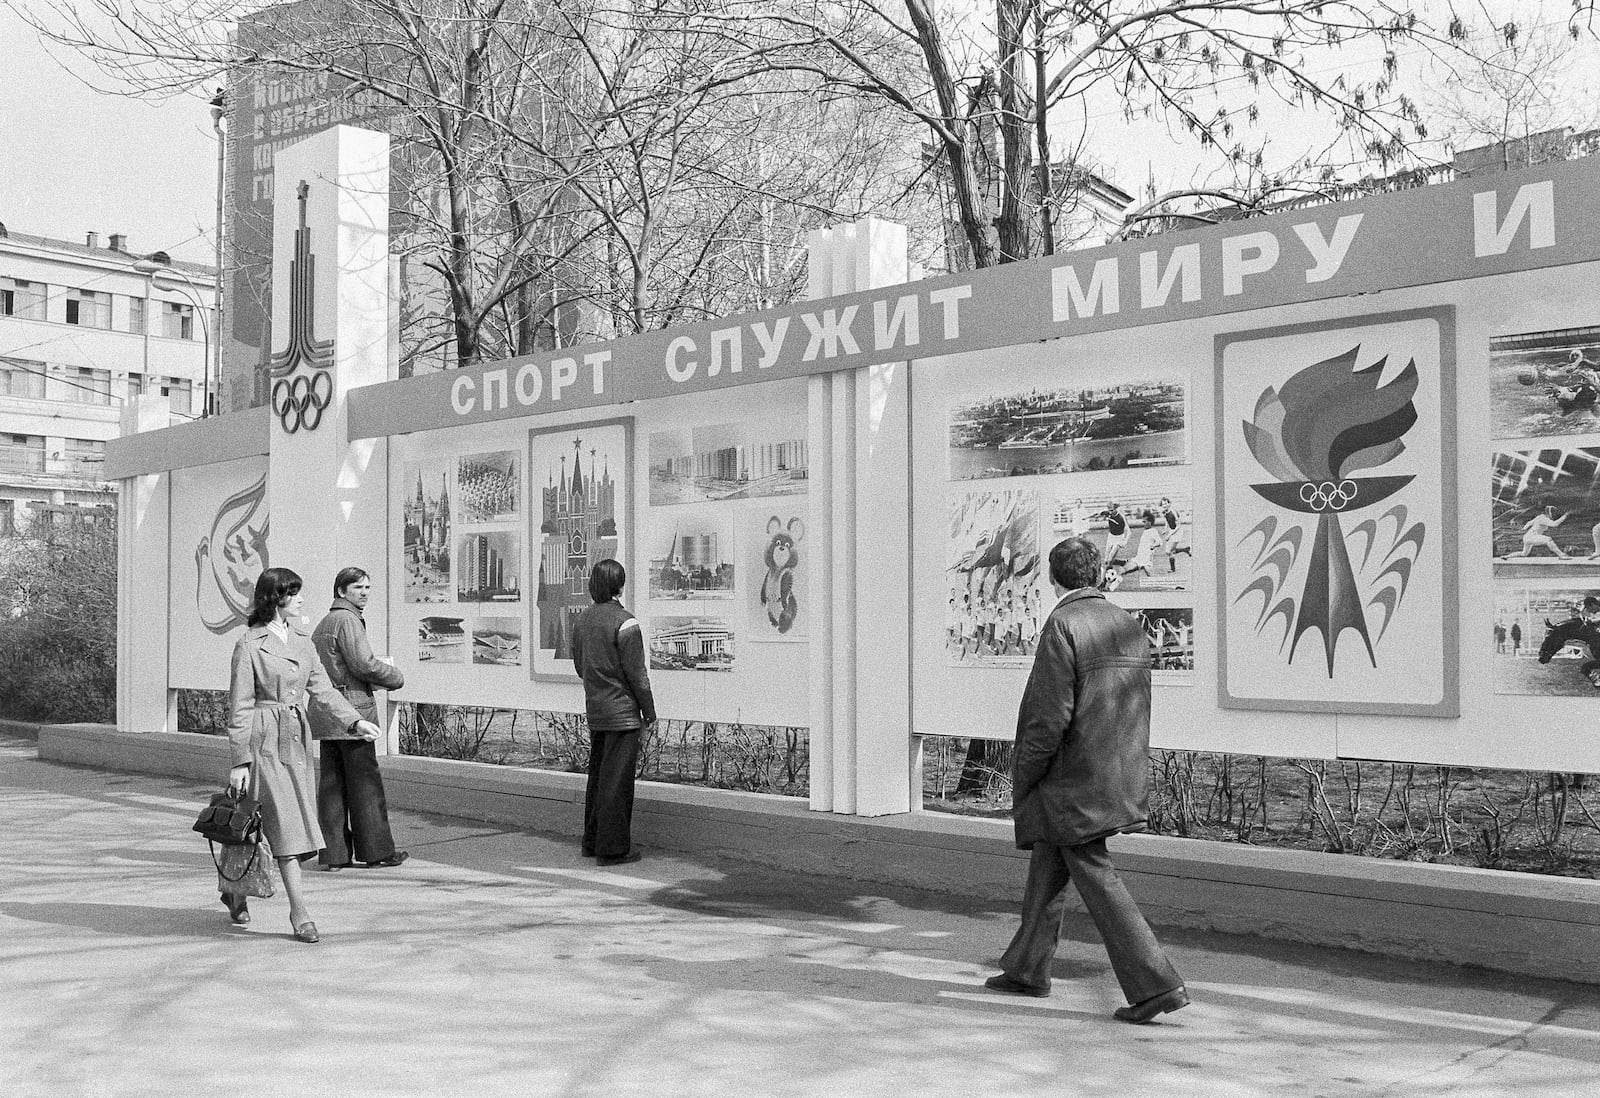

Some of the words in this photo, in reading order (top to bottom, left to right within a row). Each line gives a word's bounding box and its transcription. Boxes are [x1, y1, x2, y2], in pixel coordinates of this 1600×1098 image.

[451, 350, 612, 415] СПОРТ
[665, 284, 972, 383] СЛУЖИТ
[1051, 213, 1364, 322] МИРУ
[1473, 179, 1556, 258] И
